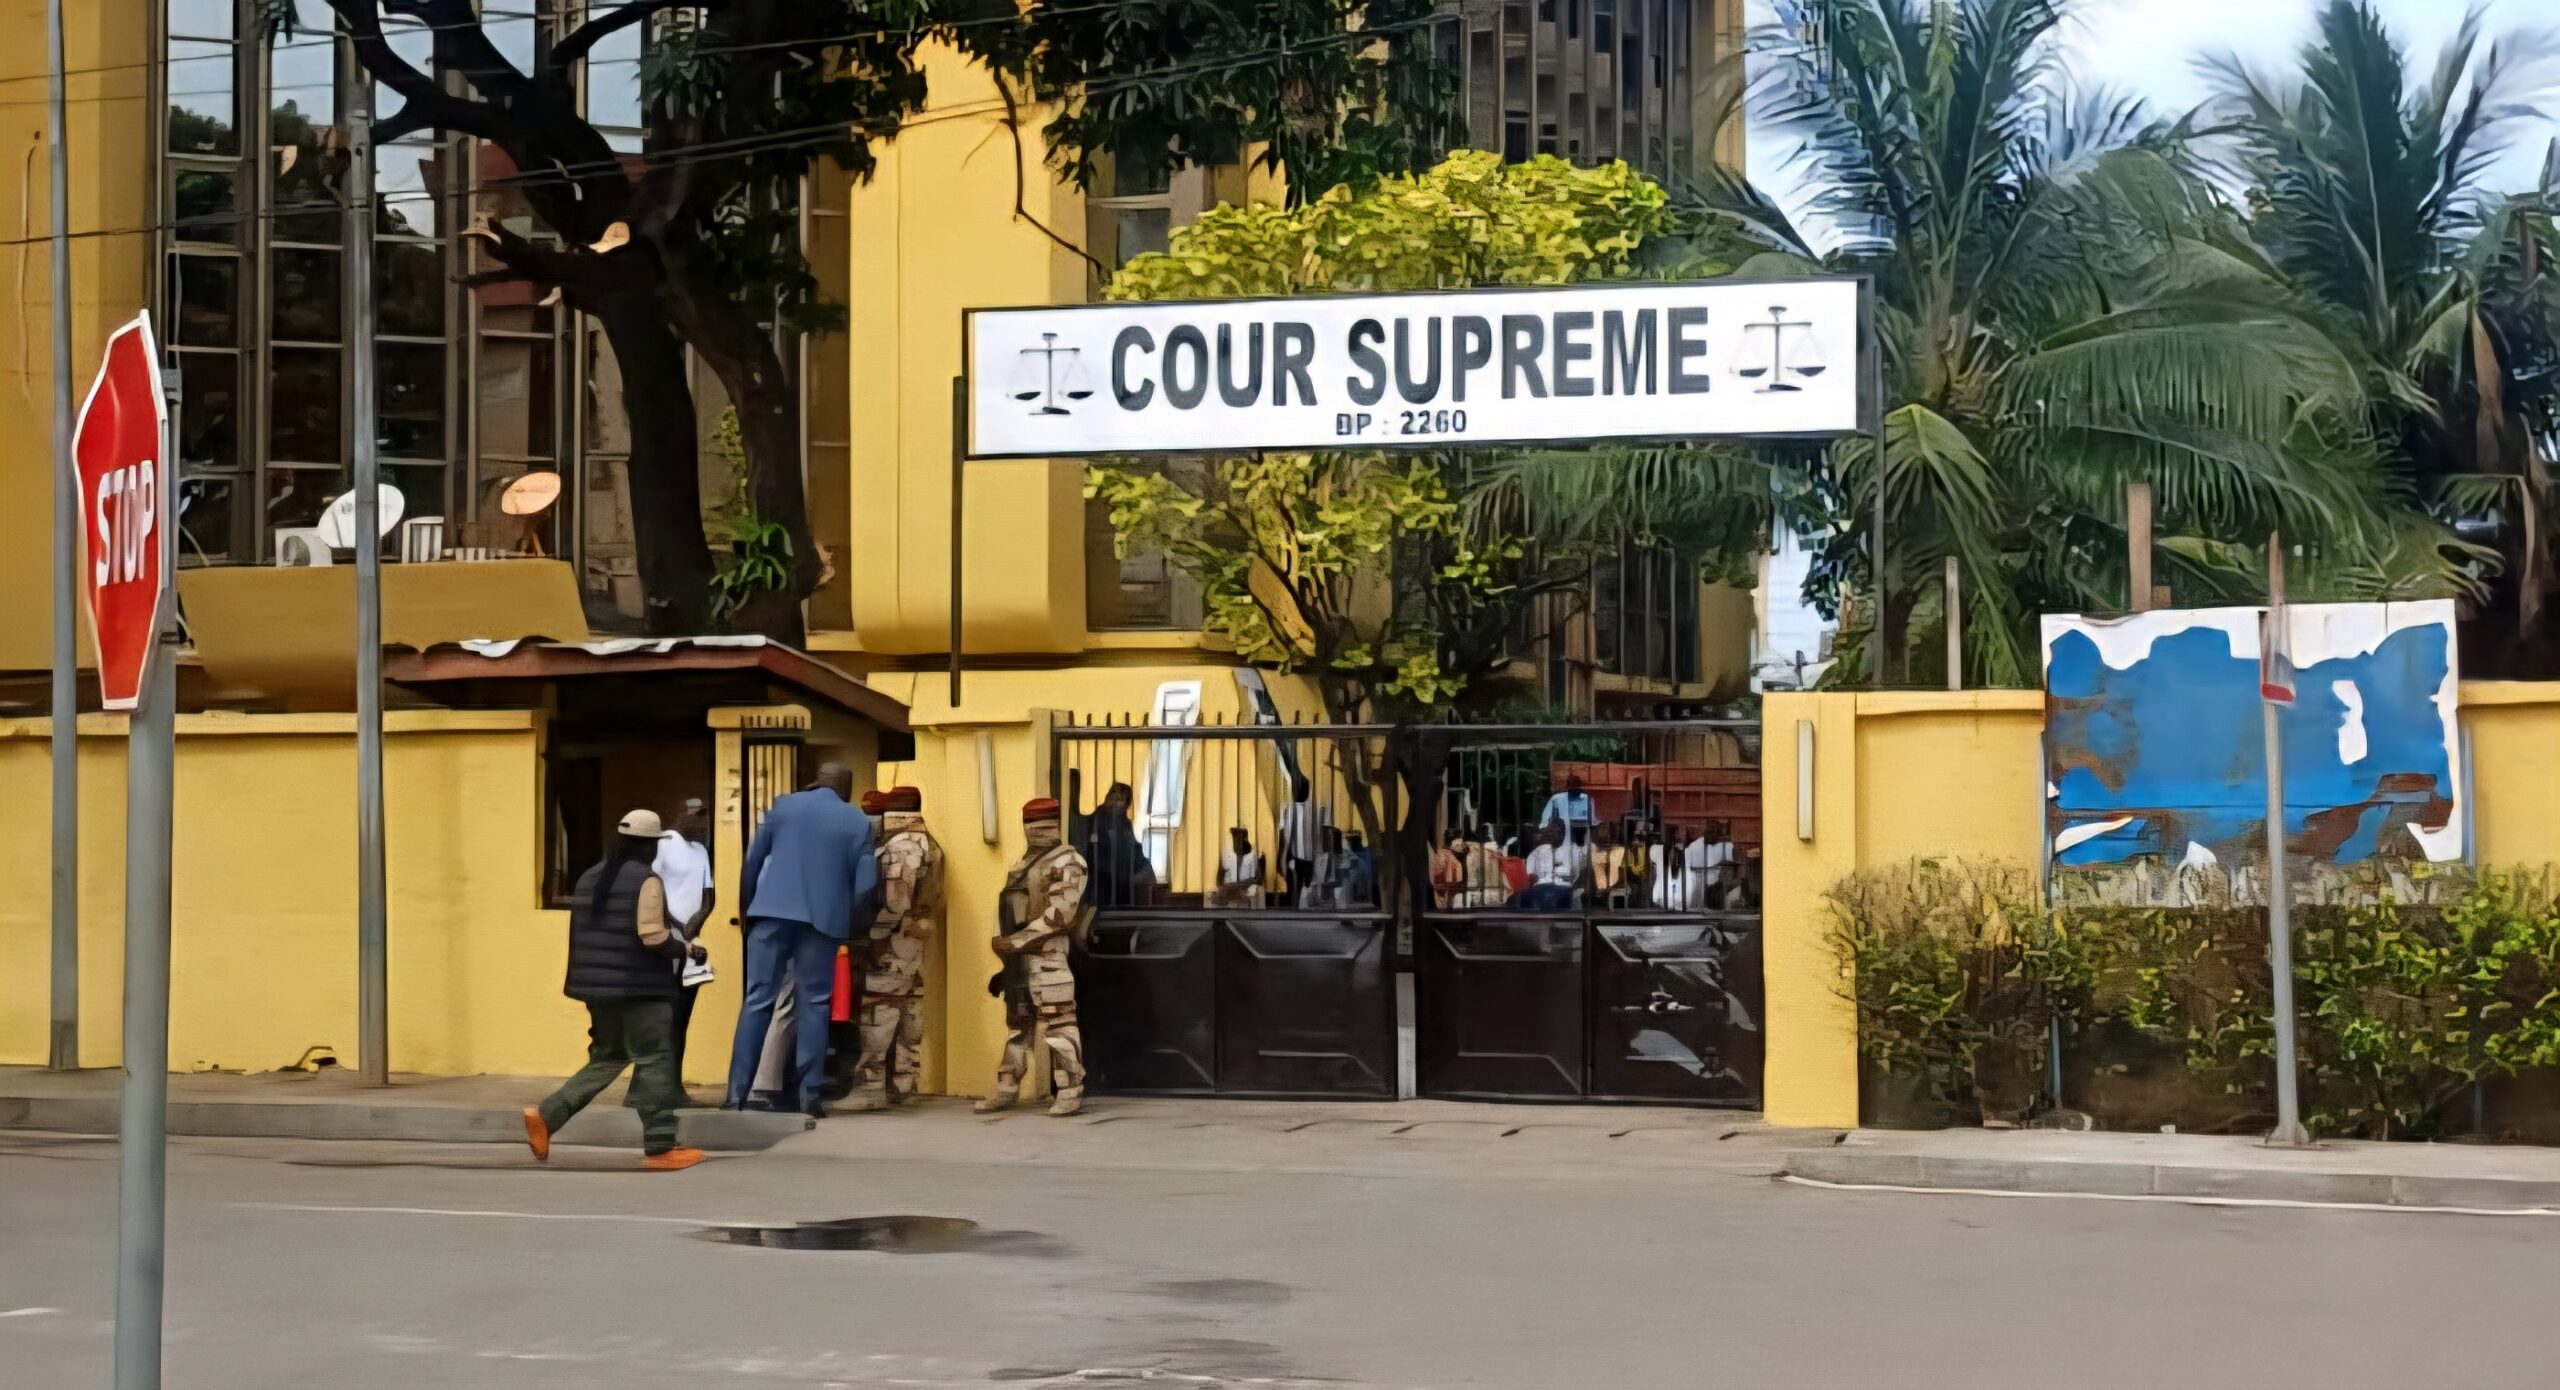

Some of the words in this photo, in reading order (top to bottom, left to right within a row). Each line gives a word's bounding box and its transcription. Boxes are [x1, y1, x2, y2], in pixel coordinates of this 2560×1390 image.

[1111, 322, 1318, 412] COUR
[1346, 307, 1710, 406] SUPREME
[1400, 409, 1467, 435] 2260
[97, 460, 154, 586] STOP
